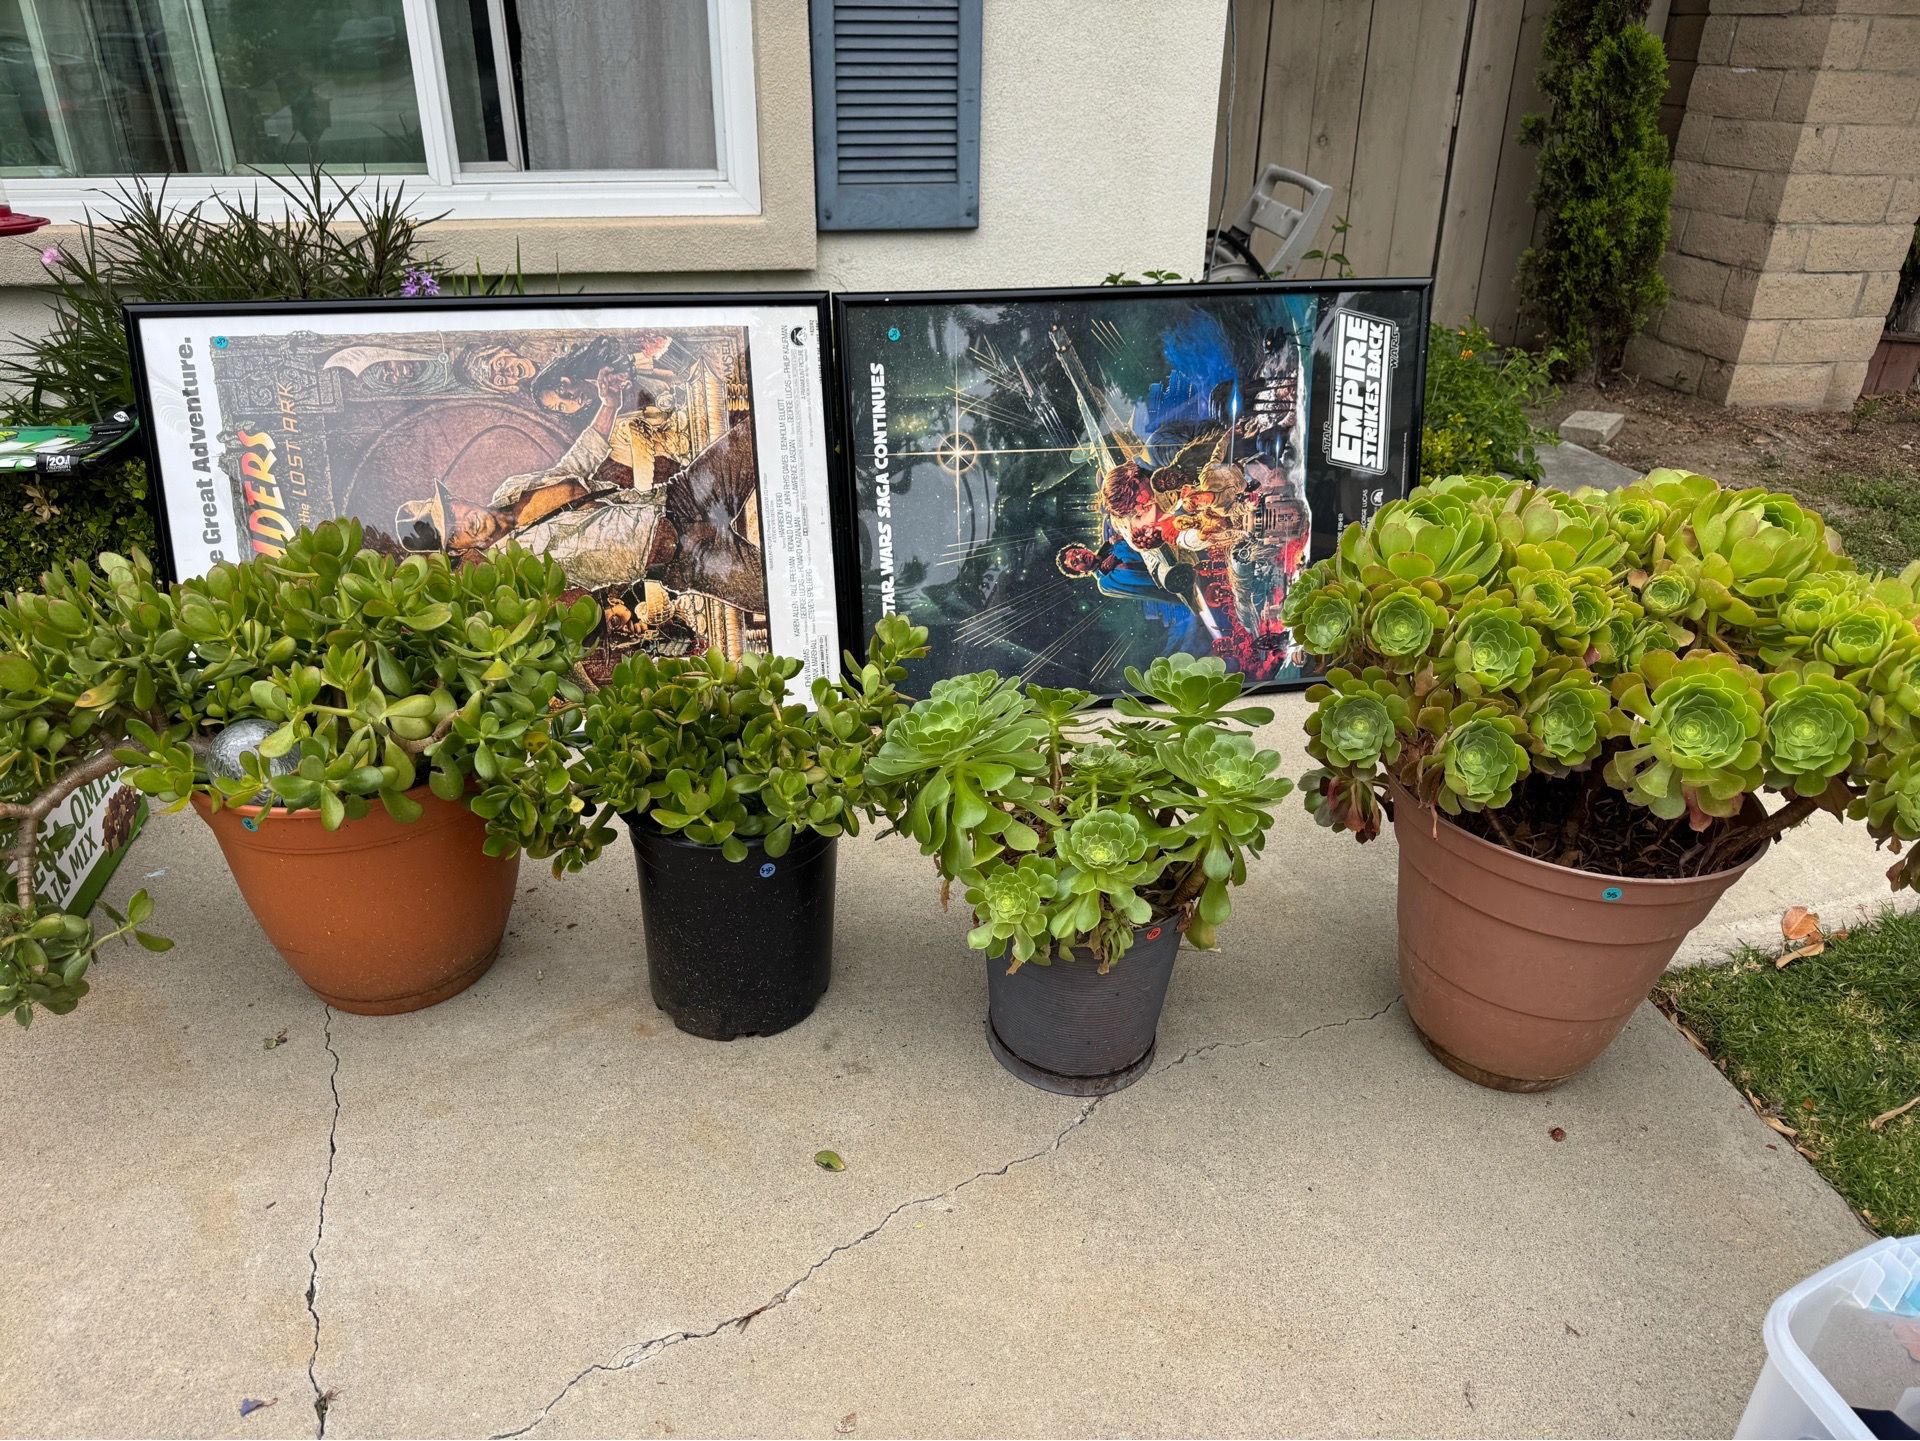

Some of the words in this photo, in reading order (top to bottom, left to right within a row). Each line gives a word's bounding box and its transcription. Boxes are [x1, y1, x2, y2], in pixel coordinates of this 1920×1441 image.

[1367, 321, 1384, 378] BACK
[1390, 332, 1400, 368] WARS
[177, 336, 211, 473] Adventure.
[276, 381, 299, 433] ARK
[785, 380, 793, 398] LUCAS
[1332, 315, 1369, 465] EMPIRE
[1334, 377, 1342, 404] THE
[870, 362, 889, 470] CONTINUES
[1321, 422, 1332, 453] STAR
[1362, 380, 1380, 468] STRIKES
[235, 430, 296, 559] IDERS
[285, 439, 308, 497] LOST
[196, 478, 222, 545] Great
[775, 492, 783, 508] FORD
[875, 472, 892, 518] SAGA
[776, 509, 785, 537] HARRISON
[877, 521, 894, 576] WARS
[791, 601, 799, 618] ALLEN
[792, 619, 801, 637] KAREN
[68, 826, 98, 880] MIX
